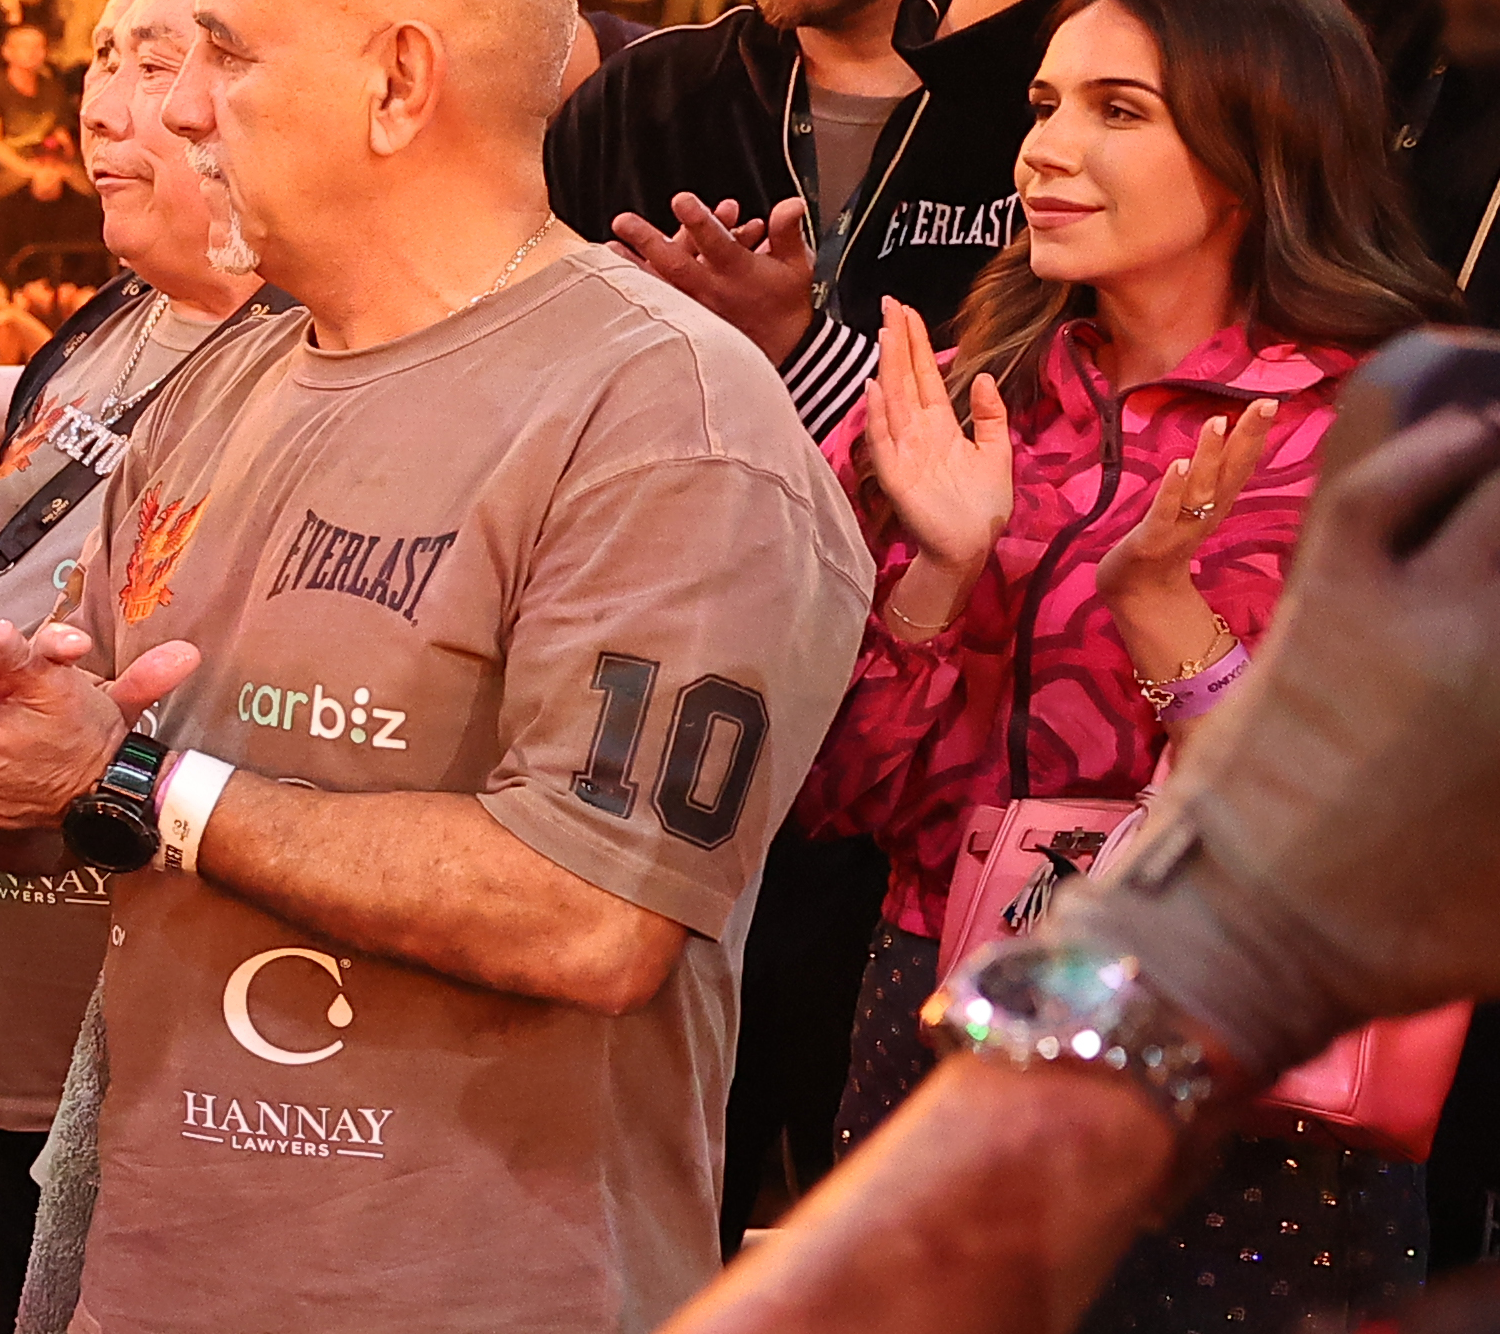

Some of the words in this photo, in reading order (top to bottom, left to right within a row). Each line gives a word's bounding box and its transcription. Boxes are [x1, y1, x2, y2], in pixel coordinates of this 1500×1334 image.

[266, 508, 459, 621] EVERLAST
[569, 650, 770, 852] 10
[182, 1090, 394, 1146] HANNAY
[232, 1135, 330, 1157] LAWYERS
